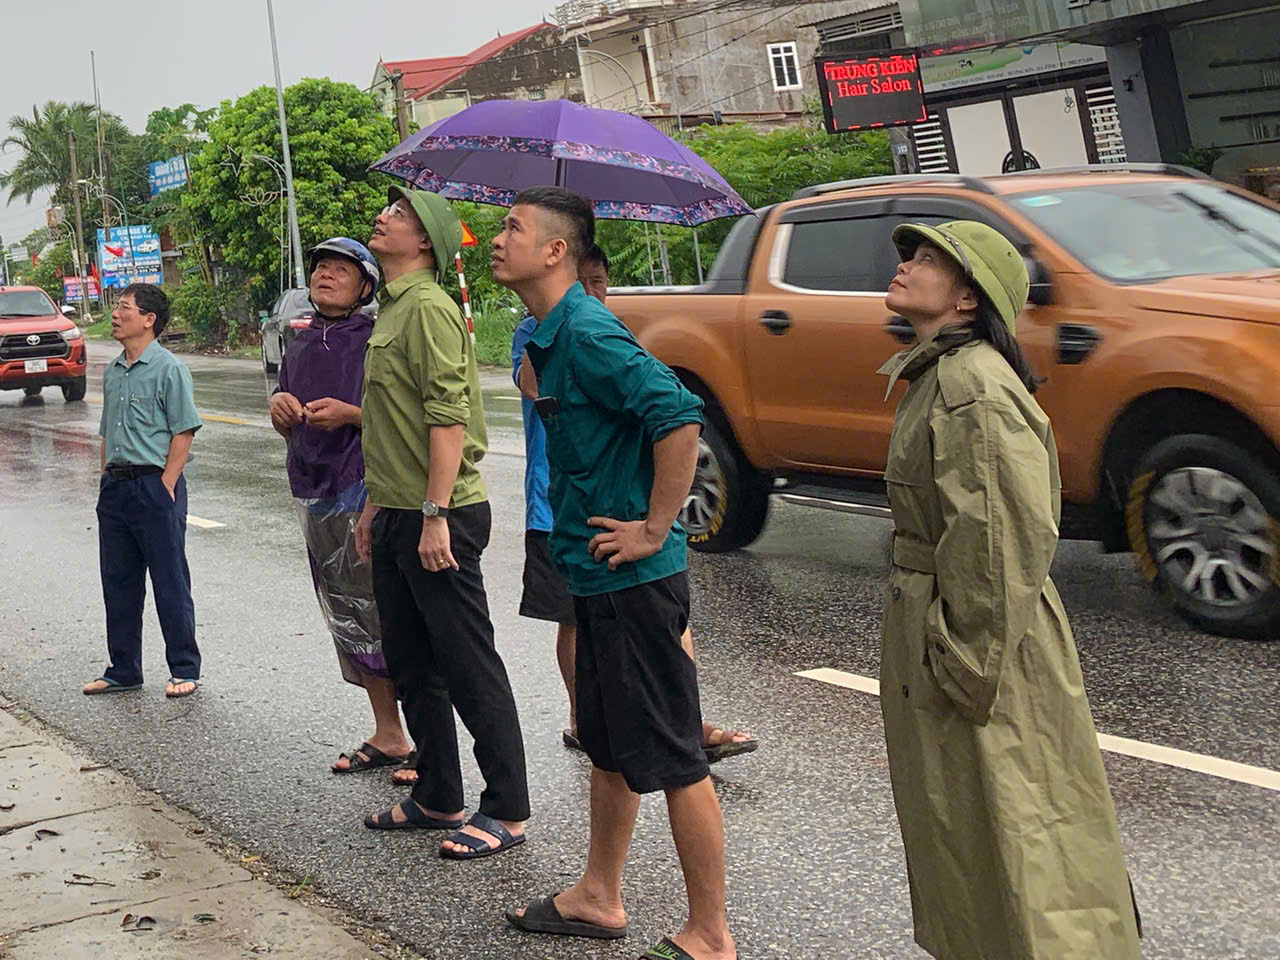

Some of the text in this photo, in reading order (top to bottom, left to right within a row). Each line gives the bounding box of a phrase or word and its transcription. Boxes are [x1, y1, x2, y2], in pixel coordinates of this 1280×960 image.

[826, 64, 878, 80] TRUNG
[837, 77, 912, 97] Hair Salon
